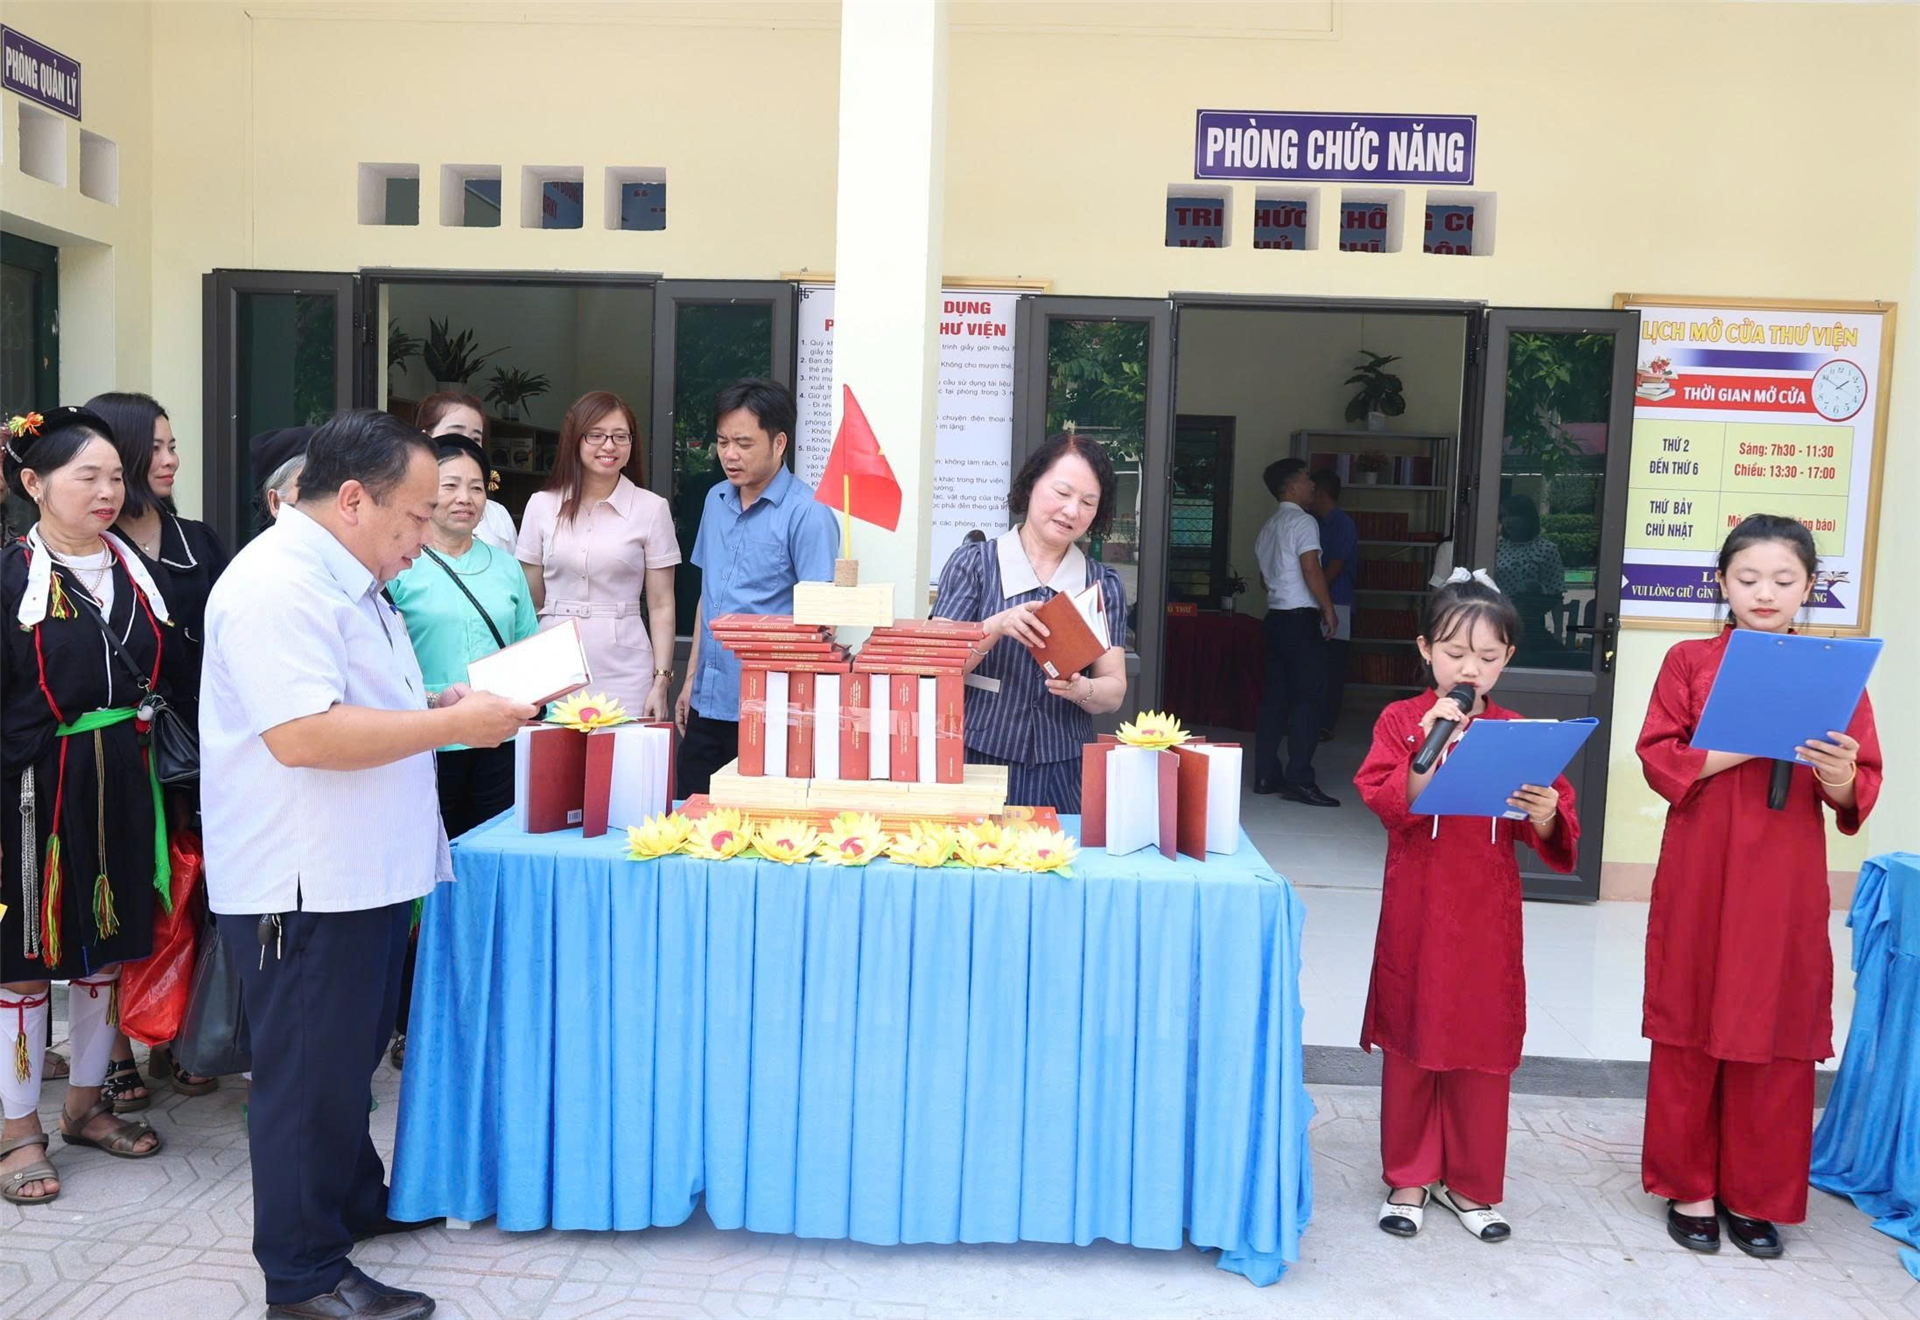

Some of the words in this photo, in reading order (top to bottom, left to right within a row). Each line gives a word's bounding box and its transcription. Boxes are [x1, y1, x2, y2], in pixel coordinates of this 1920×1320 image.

[6, 45, 38, 90] PHÒNG
[40, 59, 65, 102] QUẢN
[66, 72, 77, 107] LÝ
[1206, 118, 1298, 170] PHÒNG
[1307, 122, 1379, 171] CHỨC
[1387, 123, 1464, 173] NĂNG
[1255, 205, 1307, 228] HỨC
[944, 301, 991, 316] DỤNG
[940, 322, 963, 335] HƯ
[967, 321, 1006, 339] VIỆN
[1642, 320, 1686, 345] LỊCH
[1690, 316, 1723, 343] MỞ
[1725, 317, 1765, 344] CỬA
[1769, 322, 1811, 346] THƯ
[1812, 321, 1858, 351] VIỆN
[1683, 383, 1716, 401] THỜI
[1718, 388, 1751, 402] GIAN
[1753, 384, 1776, 403] MỞ
[1778, 386, 1806, 405] CỬA
[1662, 437, 1682, 452] THỨ
[1683, 439, 1690, 452] 2
[1739, 442, 1768, 457] Sáng:
[1770, 444, 1795, 457] 7h30
[1806, 445, 1834, 458] 11:30
[1649, 457, 1668, 474] ĐẾN
[1672, 458, 1691, 475] THỨ
[1692, 462, 1699, 475] 6
[1769, 465, 1797, 478] 13:30
[1807, 466, 1835, 479] 17:00
[1650, 498, 1669, 514] THỨ
[1673, 497, 1692, 515] BẢY
[1645, 519, 1665, 536] CHỦ
[1667, 522, 1694, 540] NHẬT
[1816, 518, 1836, 532] báo)
[1632, 585, 1647, 596] VUI
[1649, 583, 1674, 597] LÒNG
[1676, 585, 1694, 598] GIỮ
[1696, 585, 1713, 598] GÌN
[1811, 592, 1827, 603] NG
